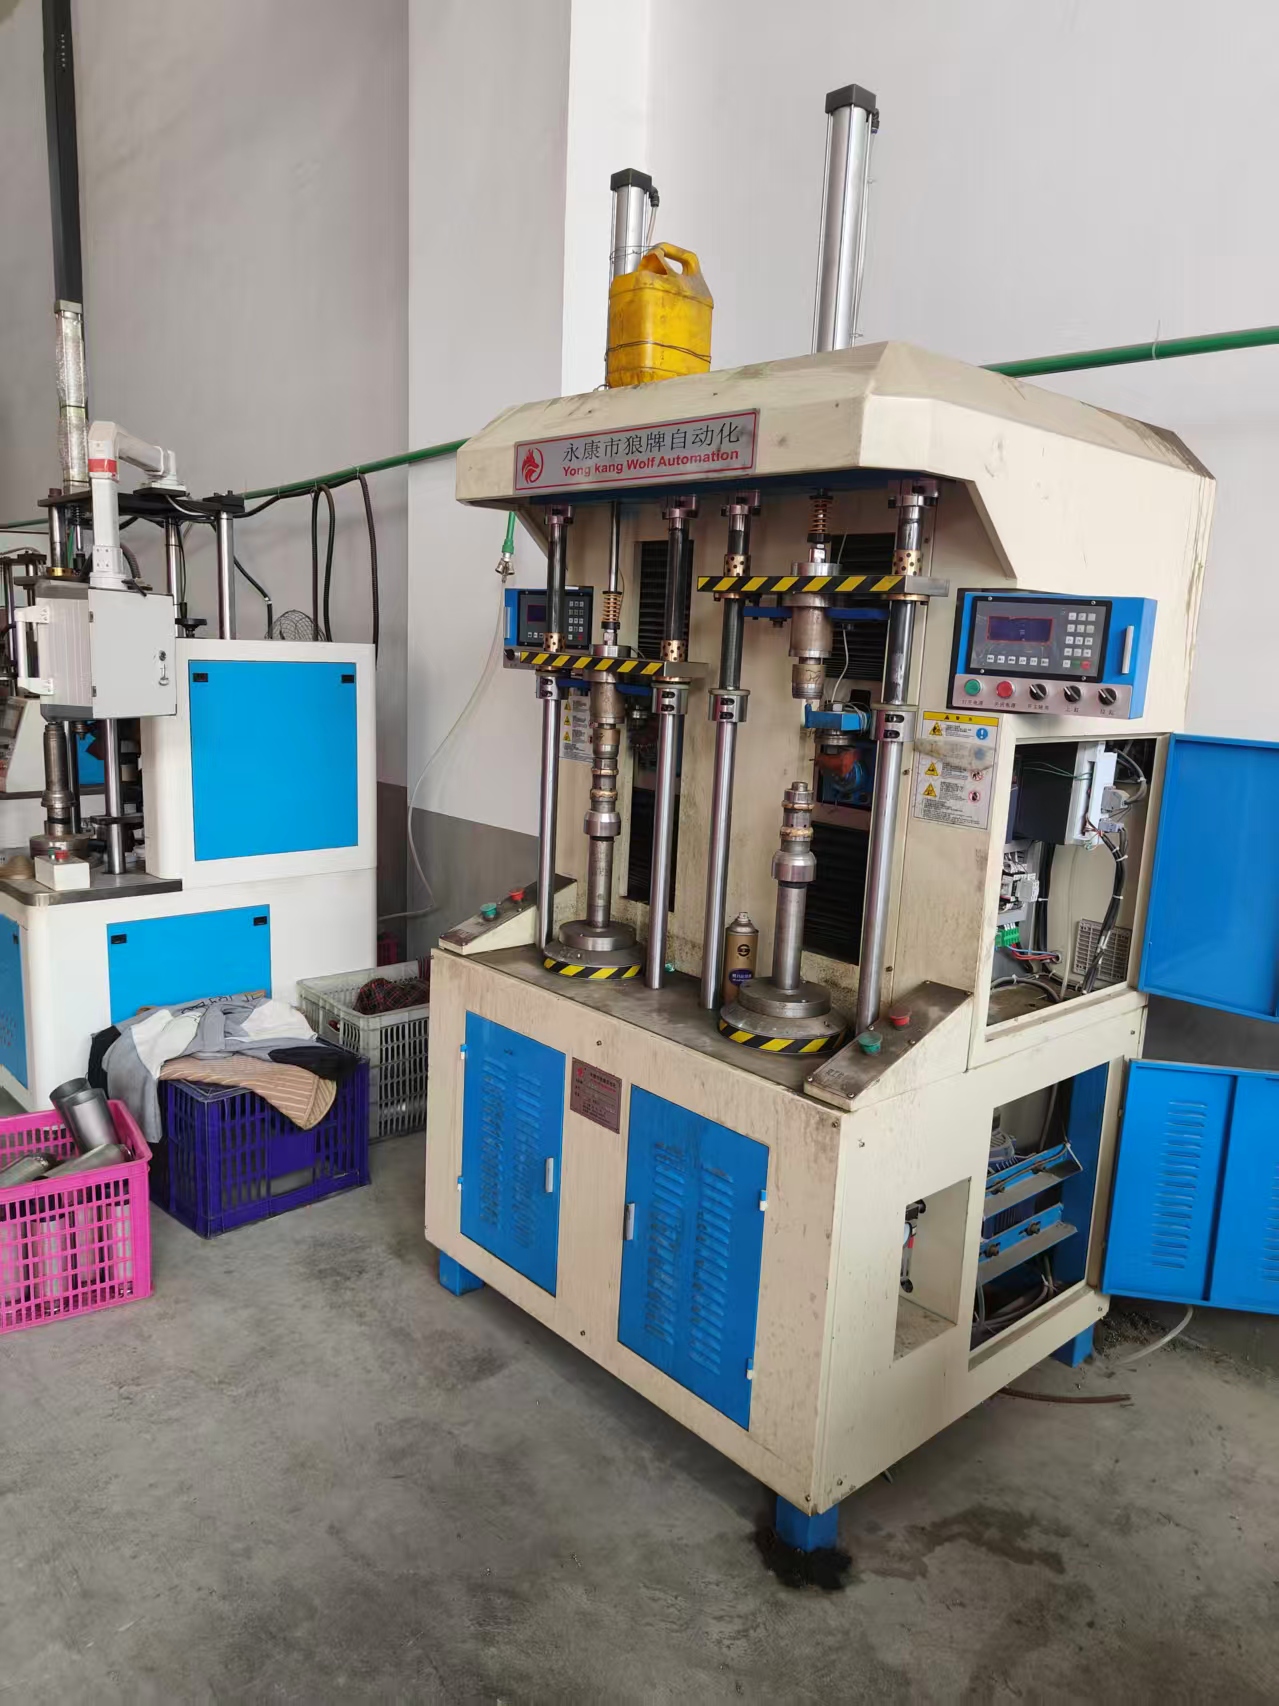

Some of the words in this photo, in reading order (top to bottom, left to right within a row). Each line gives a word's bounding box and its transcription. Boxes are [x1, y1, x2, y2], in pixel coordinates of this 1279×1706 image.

[562, 422, 740, 462] 永康市狼牌自动化
[562, 465, 592, 477] Yong
[594, 461, 624, 475] kang
[626, 457, 656, 471] Wolf
[657, 449, 739, 467] Automation
